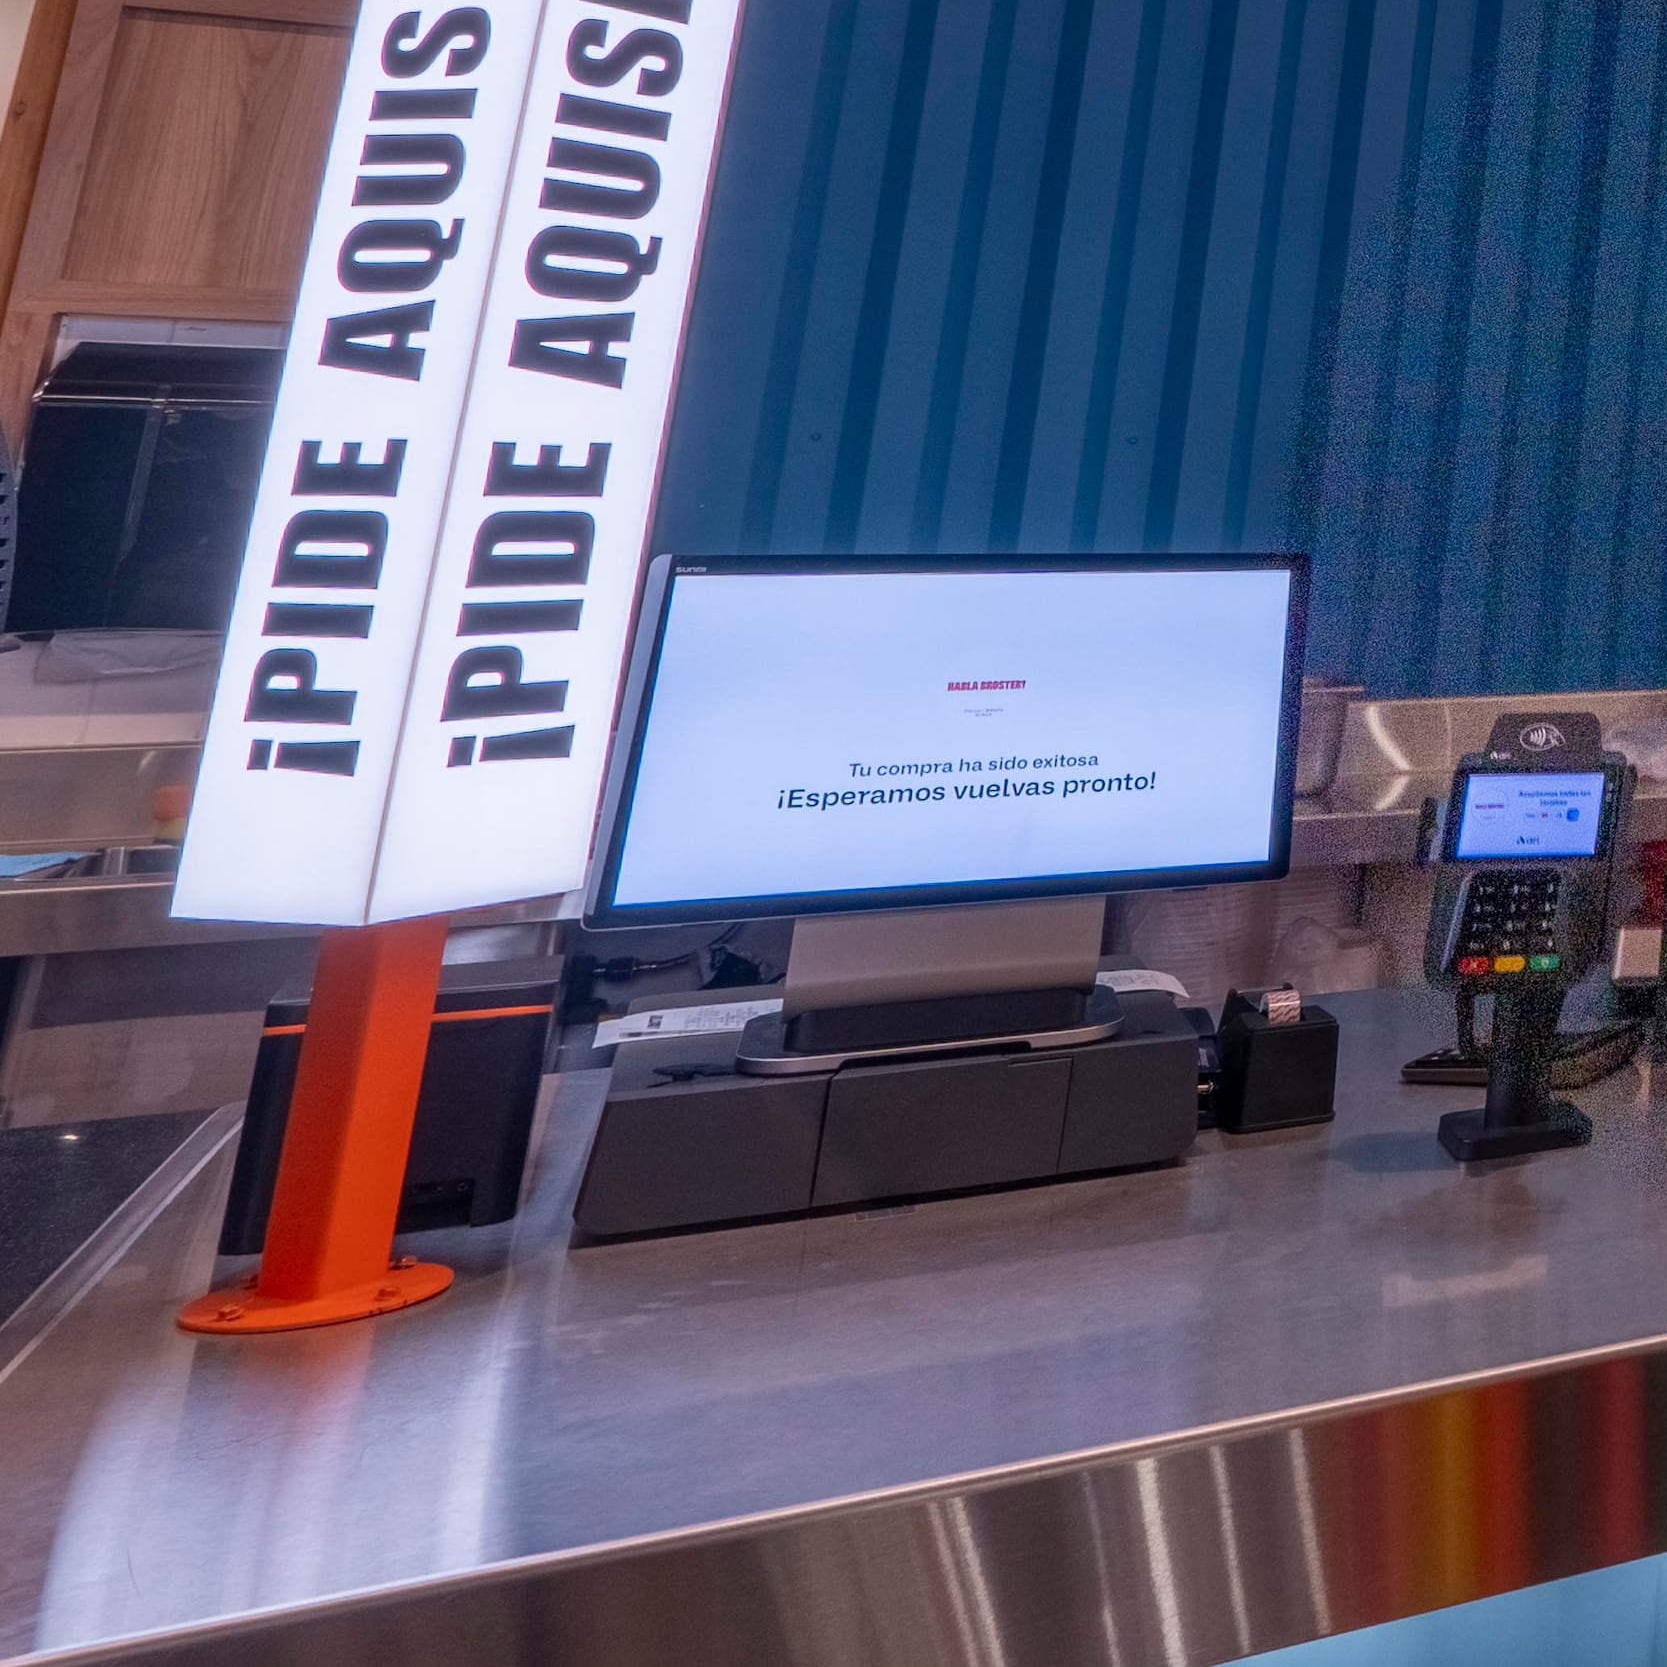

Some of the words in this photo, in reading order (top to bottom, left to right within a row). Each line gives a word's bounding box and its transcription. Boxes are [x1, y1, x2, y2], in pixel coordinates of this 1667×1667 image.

[244, 438, 409, 777] ¡PIDE
[439, 441, 613, 768] ¡PIDE
[947, 681, 979, 692] HABLA
[849, 763, 873, 779] Tu
[876, 760, 954, 779] compra
[959, 758, 984, 774] ha
[987, 755, 1029, 772] sido
[1032, 753, 1100, 770] exitosa
[777, 786, 946, 812] ¡Esperamos
[954, 778, 1056, 801] vuelvas
[1062, 771, 1157, 799] pronto!
